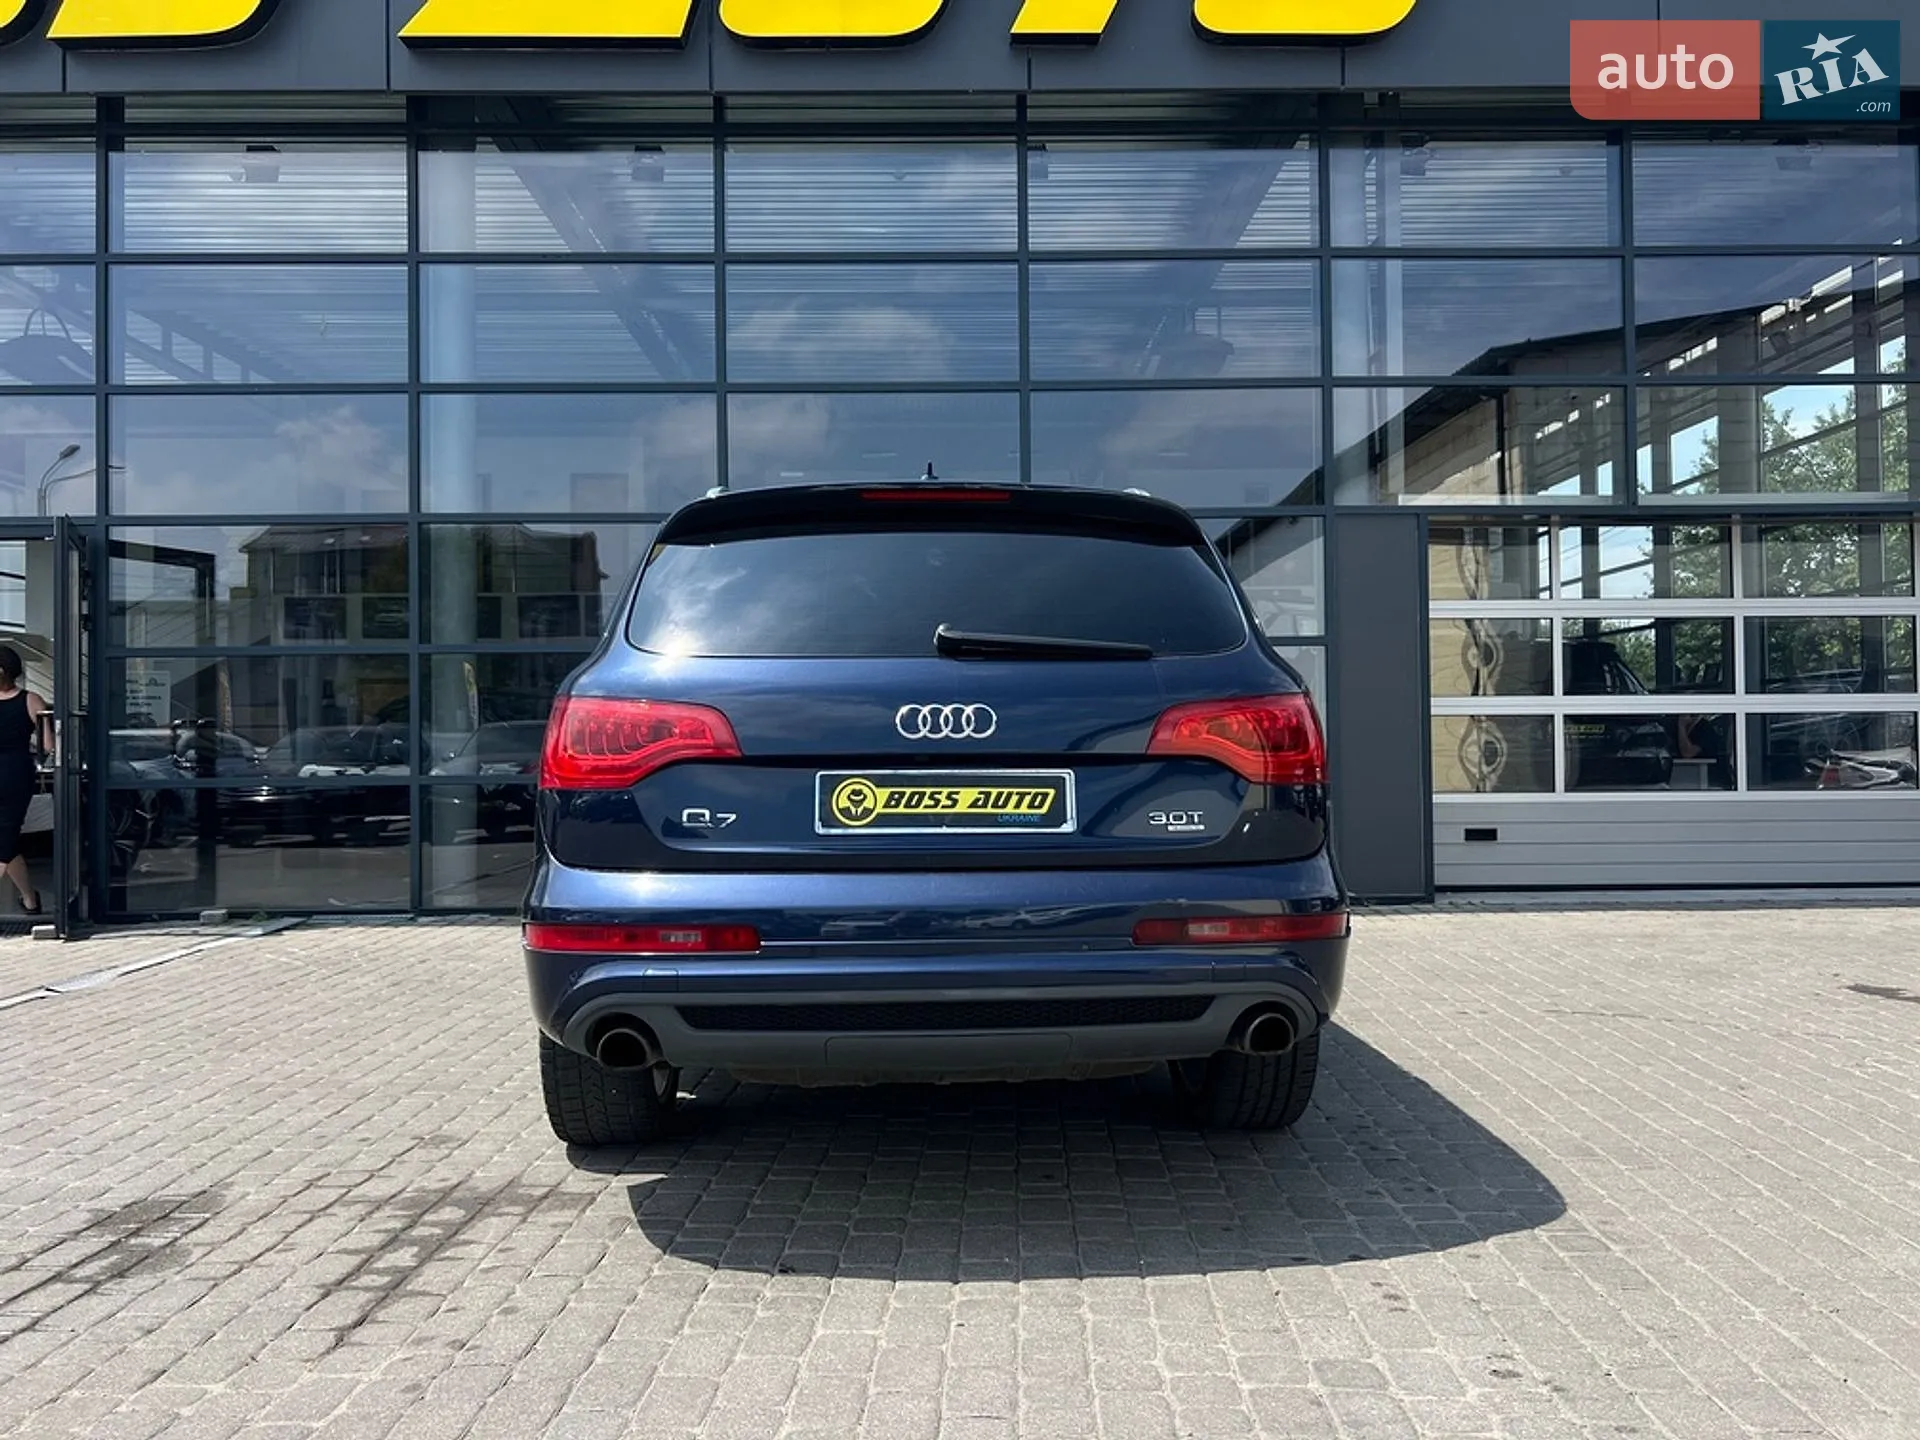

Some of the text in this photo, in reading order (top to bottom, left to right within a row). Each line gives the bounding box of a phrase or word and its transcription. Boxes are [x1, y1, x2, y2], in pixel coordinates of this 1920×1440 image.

[882, 790, 1051, 810] BOSS AUTO
[682, 808, 737, 828] Q7
